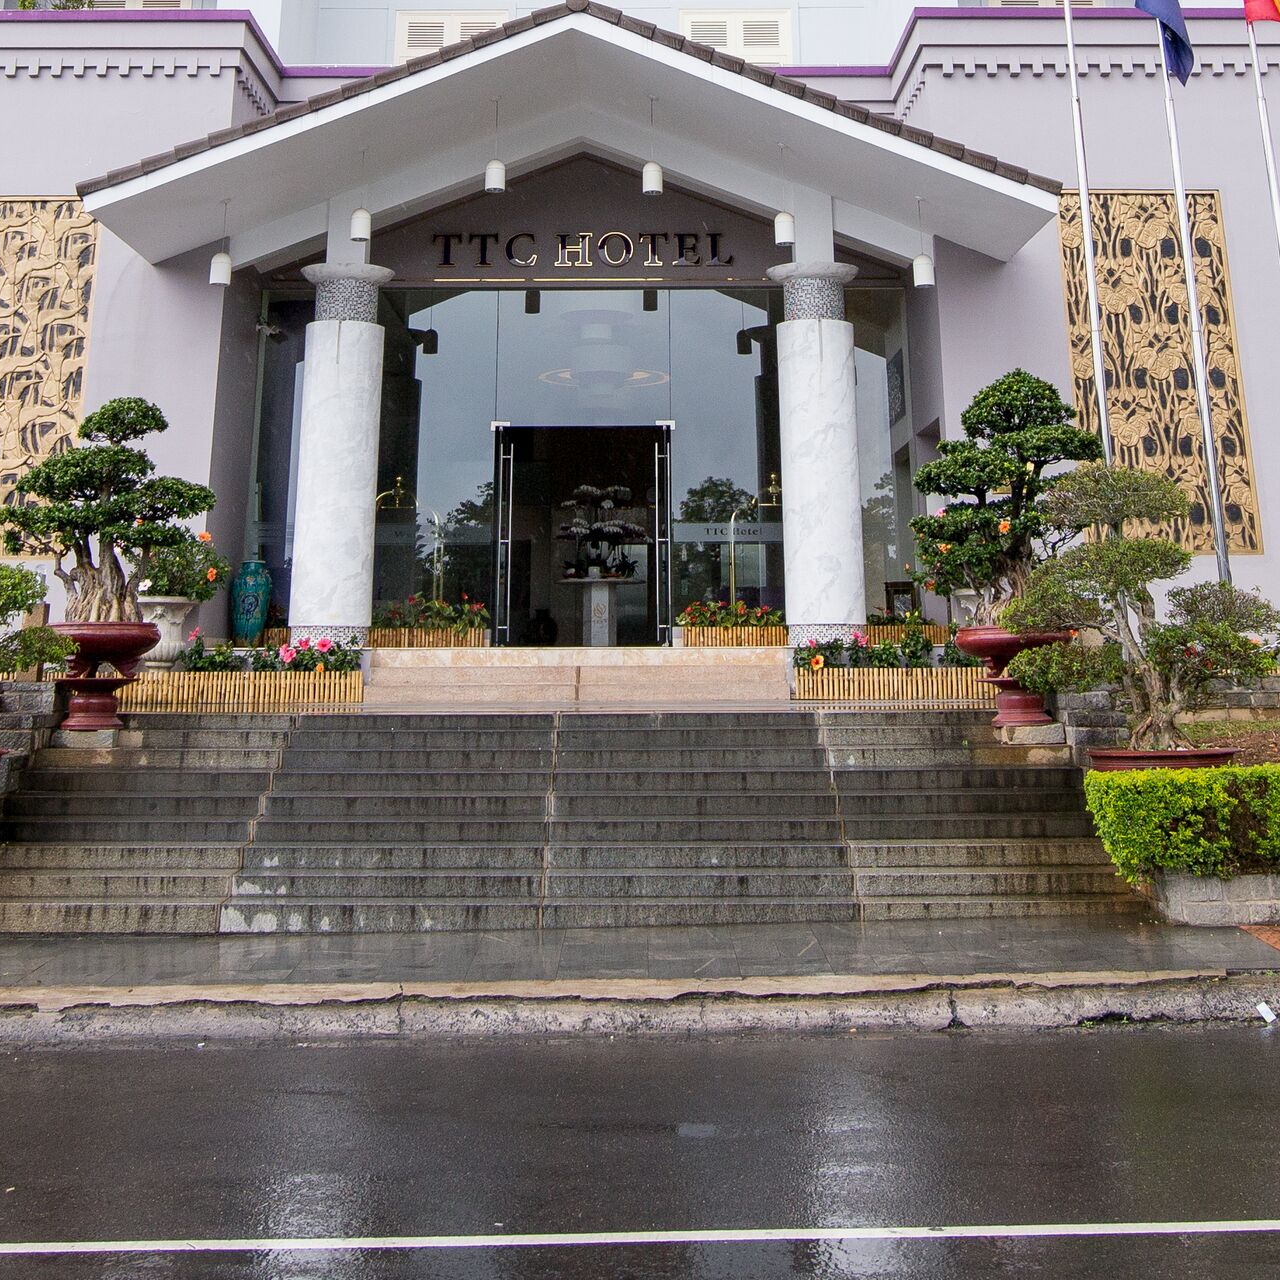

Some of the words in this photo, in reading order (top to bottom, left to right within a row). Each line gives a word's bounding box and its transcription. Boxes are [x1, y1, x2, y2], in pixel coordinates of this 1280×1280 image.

[432, 232, 538, 267] TTC
[554, 231, 734, 267] HOTEL
[704, 527, 728, 536] TTC
